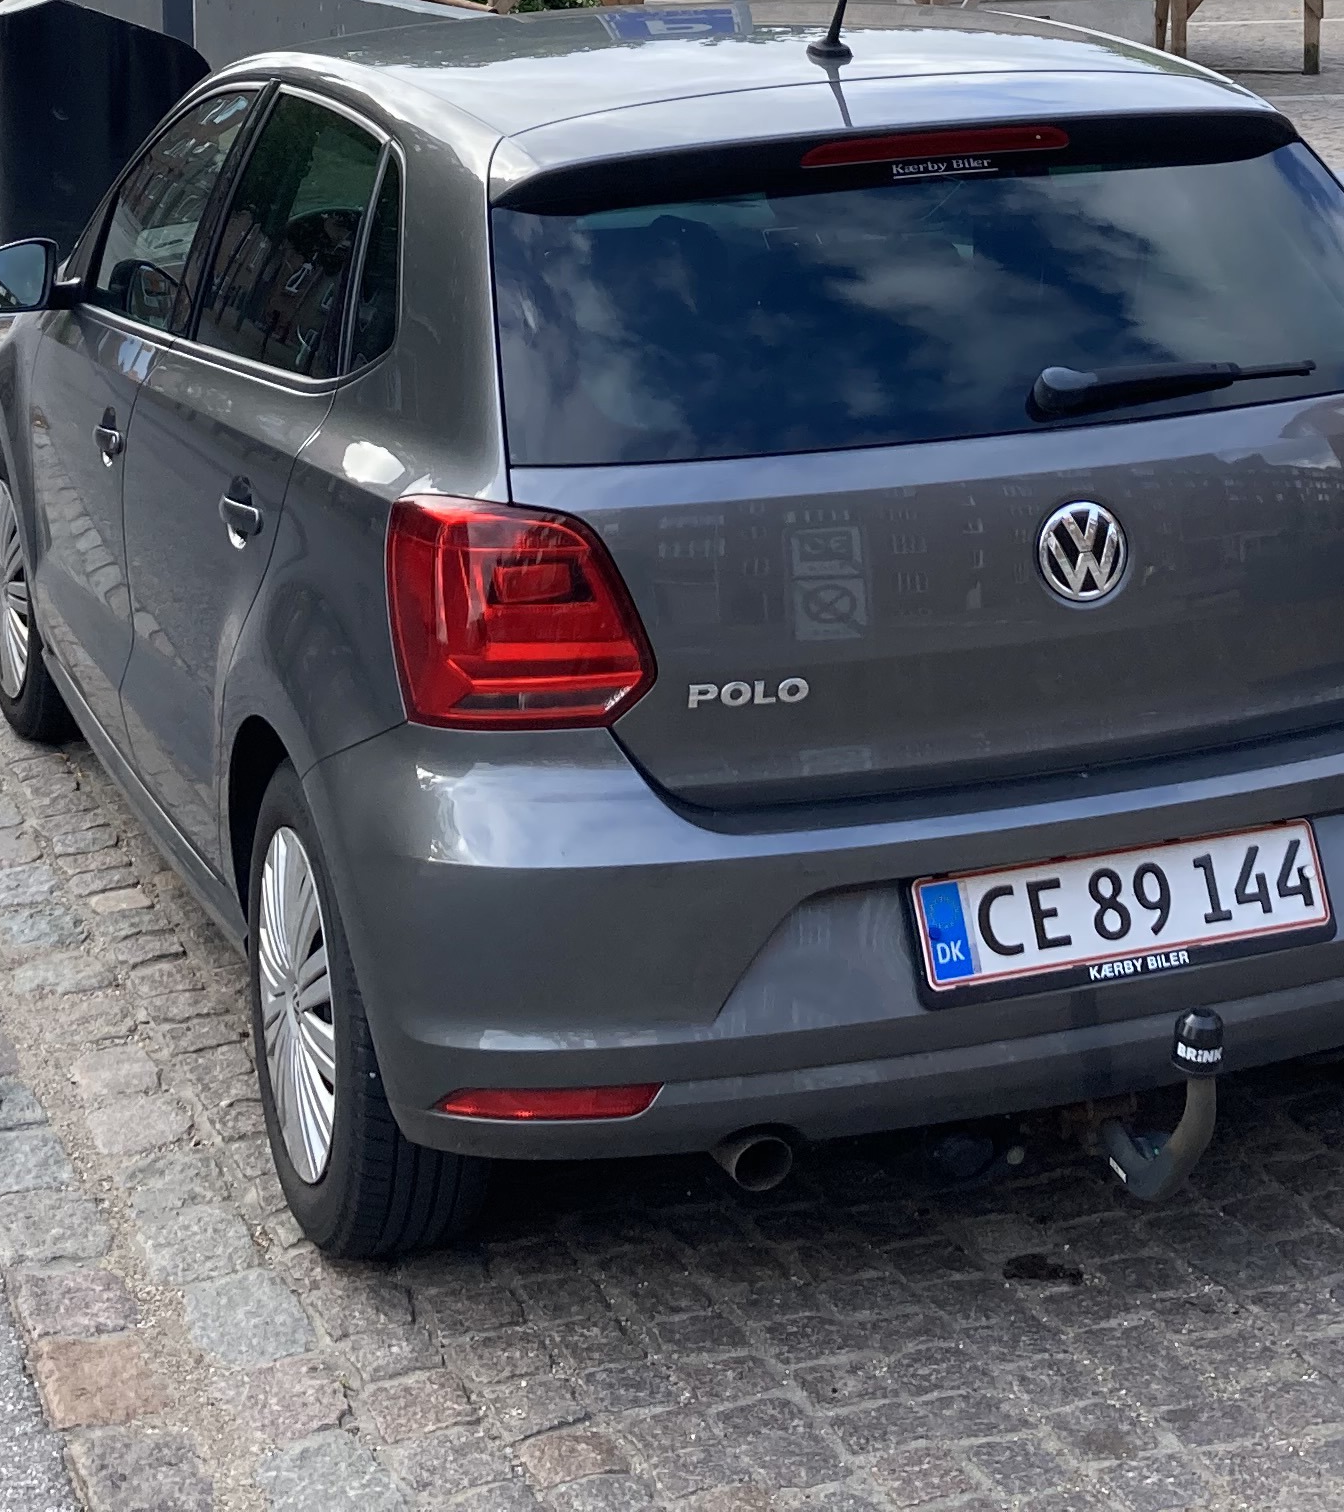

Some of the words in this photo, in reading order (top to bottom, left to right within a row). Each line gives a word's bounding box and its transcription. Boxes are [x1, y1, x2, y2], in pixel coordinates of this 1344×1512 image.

[892, 161, 947, 174] Kærby
[952, 157, 991, 169] Biler
[687, 677, 810, 709] POLO
[977, 877, 1073, 956] CE
[1088, 862, 1172, 942] 89
[1193, 839, 1316, 925] 144
[936, 939, 966, 965] DK
[1088, 958, 1143, 981] KÆRBY
[1147, 950, 1191, 971] BILER
